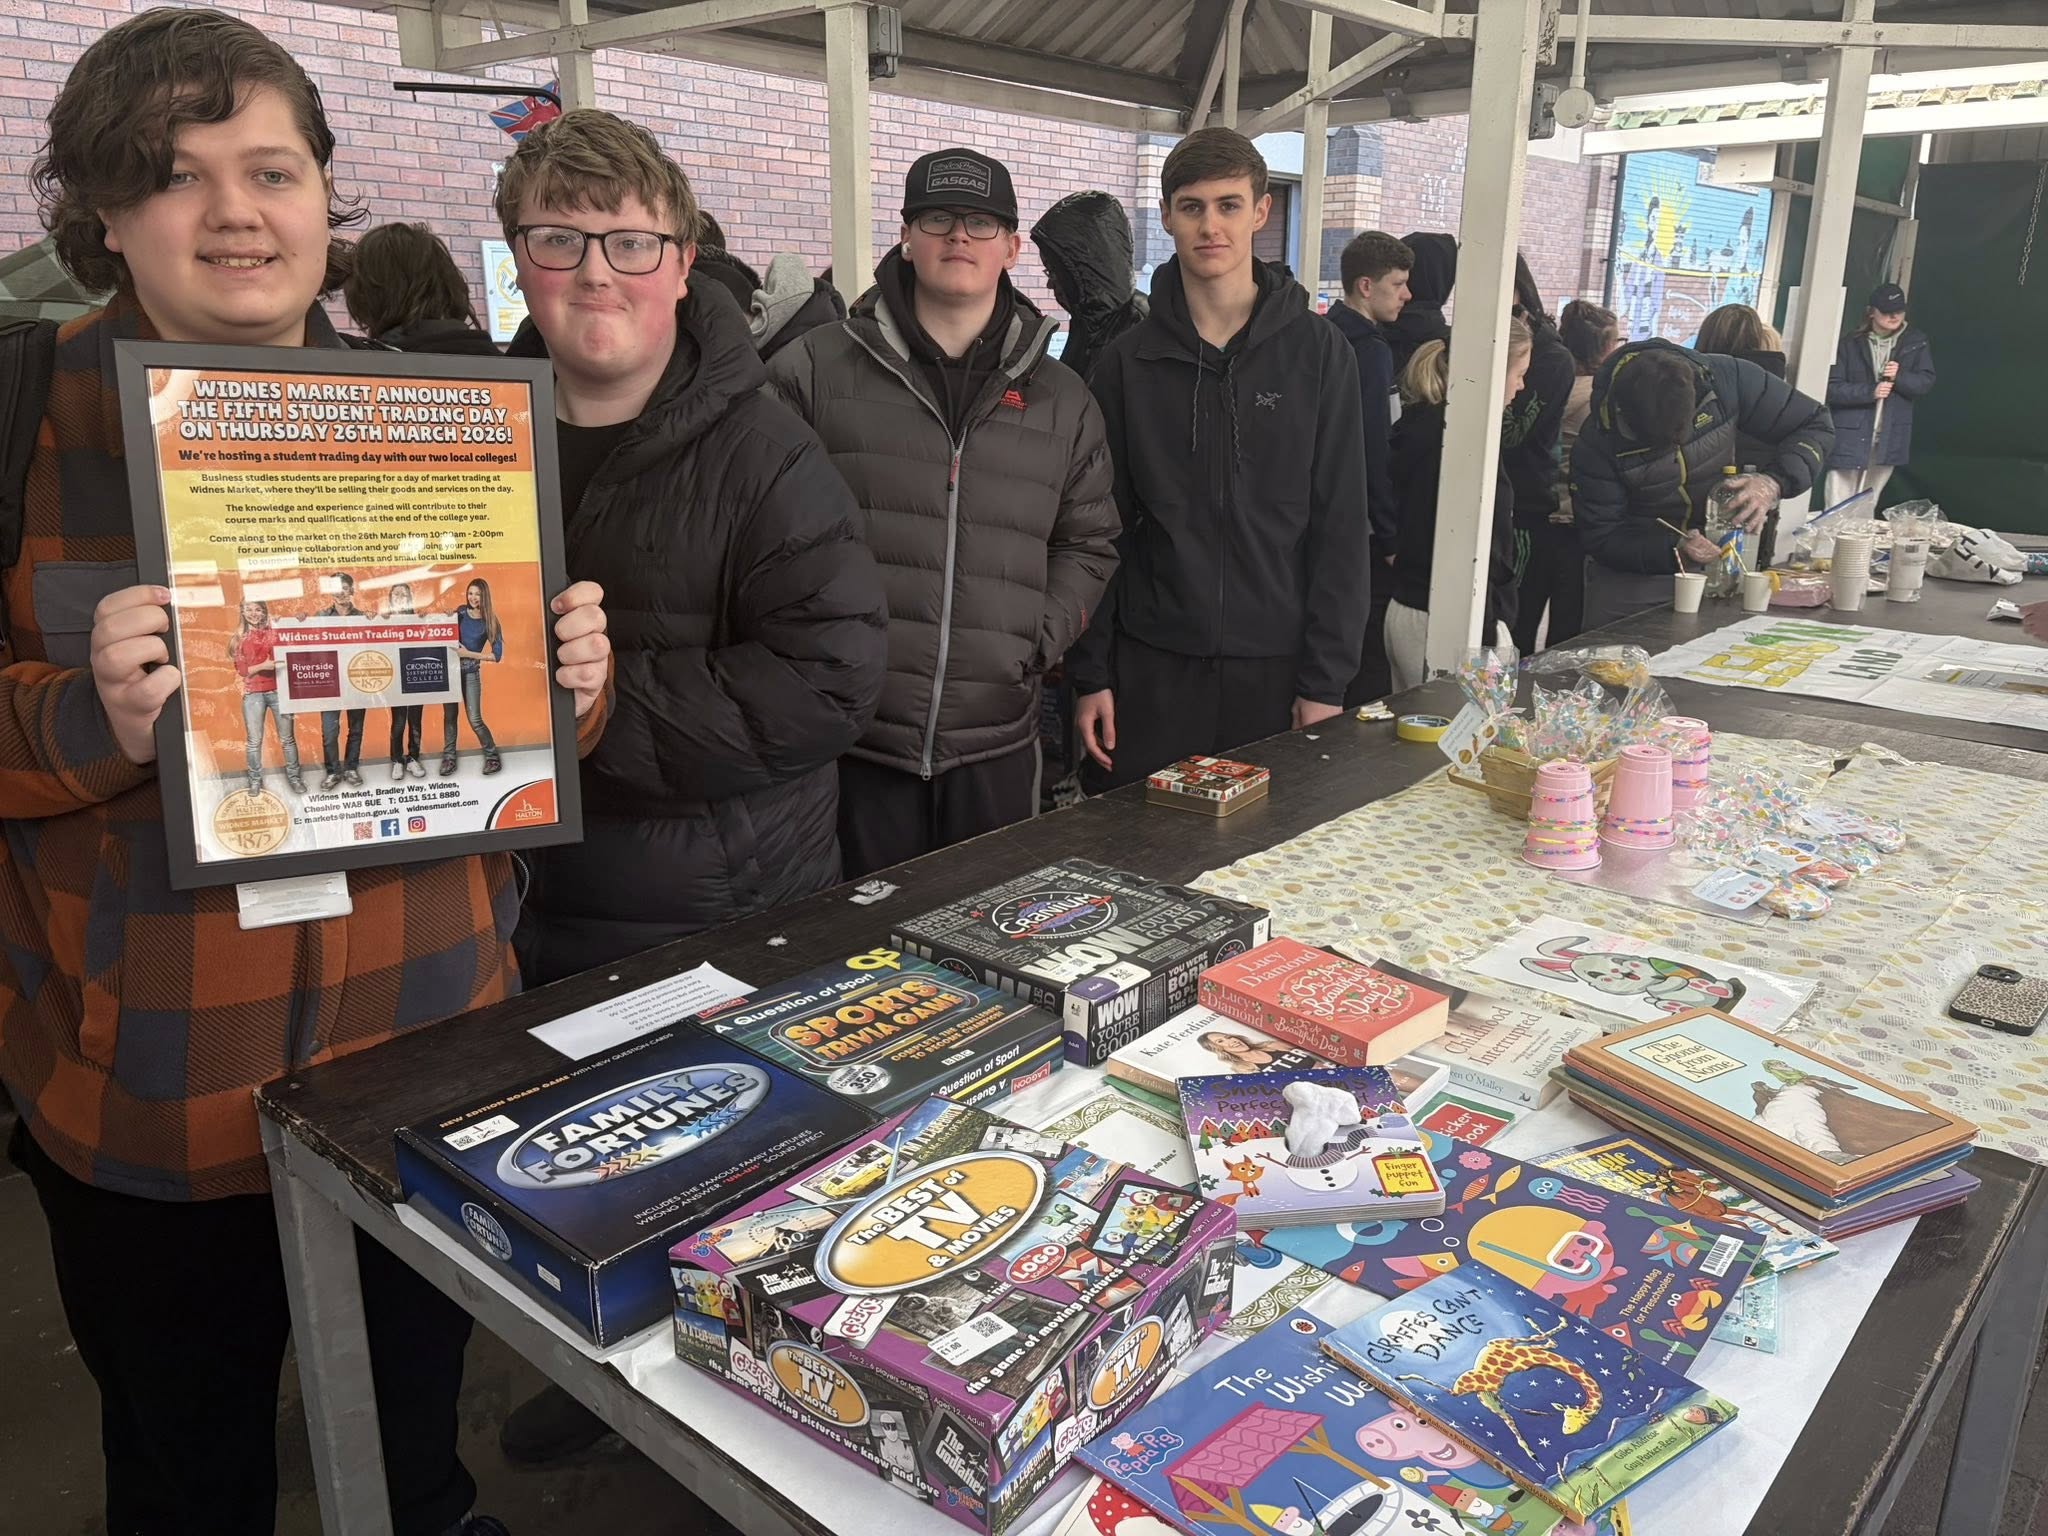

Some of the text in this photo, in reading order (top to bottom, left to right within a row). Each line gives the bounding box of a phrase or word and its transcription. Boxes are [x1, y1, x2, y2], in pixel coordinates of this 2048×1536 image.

[931, 176, 986, 191] GASGAS
[193, 380, 491, 405] WIDNES MARKET ANNOUNCES
[177, 401, 507, 425] THE FIFTH STUDENT TRADING DAY
[180, 421, 513, 444] ON THURSDAY 26TH MARCH 2026!
[179, 451, 216, 461] We're
[219, 450, 261, 462] hosting
[273, 451, 316, 461] student
[319, 452, 359, 463] trading
[362, 452, 381, 463] day
[384, 452, 407, 462] with
[429, 454, 448, 462] two
[450, 453, 473, 462] local
[475, 453, 517, 464] colleges!
[201, 474, 243, 482] Business
[245, 474, 279, 482] studies
[281, 474, 321, 482] students
[339, 475, 381, 483] preparing
[383, 474, 395, 482] for
[404, 474, 419, 483] day
[421, 474, 430, 482] of
[431, 474, 460, 482] market
[462, 474, 491, 483] trading
[278, 628, 453, 642] Widnes Student Trading Day 2026
[1827, 648, 1903, 680] LAND
[304, 791, 460, 814] Cheshire WA8 6UE T: 0151 511 8880
[309, 782, 460, 803] Widnes Market, Bradley Way, Widnes,
[304, 808, 400, 824] markets@halton.gov.uk
[406, 799, 479, 813] widnesmarket.com
[1128, 903, 1192, 932] YOU'RE
[1146, 910, 1208, 940] GOOD
[1020, 925, 1155, 984] WOW
[1168, 950, 1209, 976] YOU WERE
[1236, 951, 1288, 974] Lucy
[1239, 948, 1321, 989] Diamond
[1167, 960, 1209, 994] BORN
[1291, 975, 1324, 998] On
[1302, 967, 1371, 1016] Beautiful
[714, 1023, 734, 1035] A
[734, 993, 817, 1027] Question
[819, 983, 837, 998] of
[838, 973, 876, 993] Sport
[1097, 987, 1140, 1029] WOW
[1340, 978, 1402, 1015] Day
[784, 980, 940, 1047] SPORTS
[813, 992, 964, 1061] TRIVIA GAME
[1097, 1012, 1140, 1044] YOU'RE
[1096, 1026, 1140, 1061] GOOD
[1444, 1005, 1514, 1056] Childhood
[1467, 1010, 1543, 1066] Interrupted
[941, 1049, 976, 1066] BBC
[1139, 1037, 1172, 1059] Kate
[1522, 1027, 1589, 1080] Kathleen O'Malley
[1647, 1040, 1683, 1055] The
[1652, 1044, 1707, 1064] Gnome
[1677, 1053, 1718, 1069] from
[439, 1033, 674, 1128] NEW EDITION BOARD GAME WITH NEW QUESTION CARDS
[848, 1071, 878, 1092] 350
[1012, 1066, 1050, 1091] LAGOON
[1685, 1060, 1735, 1078] Nome
[522, 1072, 759, 1183] FORTUNES
[532, 1072, 697, 1152] FAMILY
[763, 1130, 825, 1164] SOUND EFFECT
[633, 1129, 813, 1220] INCLUDES THE FAMOUS FAMILY FORTUNES
[1384, 1162, 1417, 1171] Finger
[1385, 1169, 1424, 1182] puppet
[1398, 1177, 1419, 1188] fun
[636, 1183, 722, 1227] WRONG ANSWER
[846, 1169, 967, 1245] The BEST of
[887, 1190, 981, 1250] TV
[927, 1205, 1018, 1268] & MOVIES
[756, 1273, 781, 1285] The
[1012, 1245, 1060, 1280] LOGO
[762, 1274, 817, 1296] Godfather
[965, 1378, 992, 1395] the
[990, 1347, 1026, 1378] game
[1024, 1334, 1041, 1349] of
[1039, 1301, 1085, 1336] moving
[1079, 1267, 1124, 1305] pictures
[1120, 1254, 1140, 1269] we
[1137, 1233, 1166, 1256] know
[1164, 1216, 1184, 1235] and
[1179, 1200, 1205, 1220] love
[1619, 1268, 1663, 1318] The Happy Mag
[1633, 1312, 1646, 1325] for
[1640, 1272, 1676, 1318] Preschoolers
[840, 1296, 885, 1339] GREASE
[1366, 1289, 1484, 1364] GIRAFFES CAN'T
[1413, 1314, 1486, 1362] DANCE
[1213, 1365, 1274, 1398] The
[1265, 1359, 1339, 1404] Wishi
[1143, 1432, 1181, 1450] Pig
[1614, 1429, 1660, 1460] Giles Andreae
[1623, 1435, 1678, 1472] Guy Parker-Rees
[1108, 1443, 1160, 1476] Peppa
